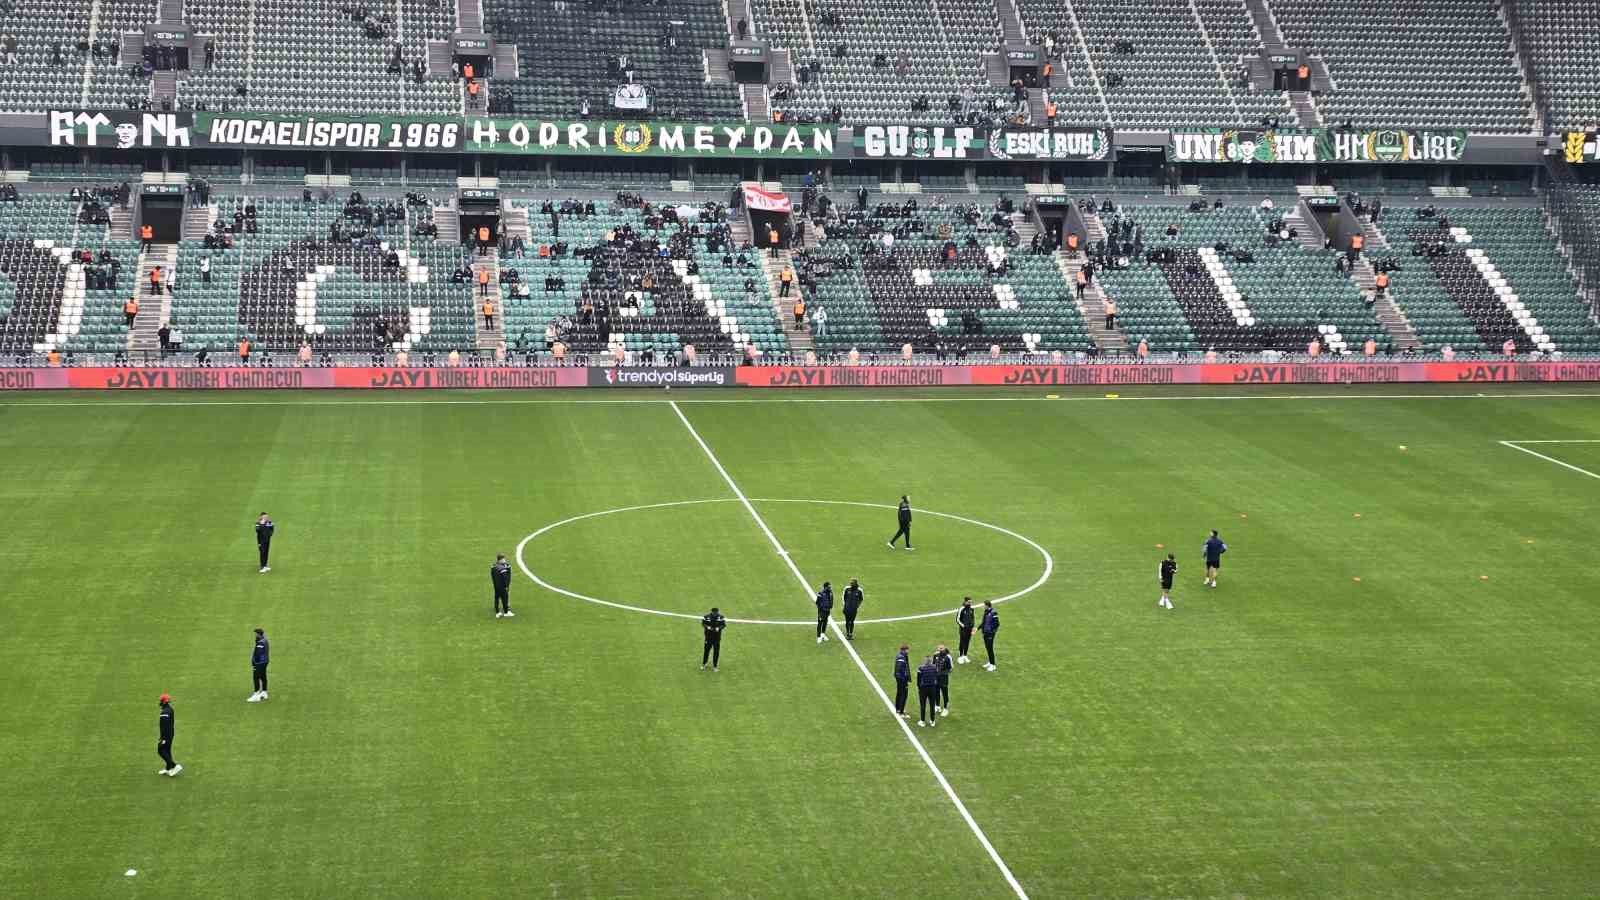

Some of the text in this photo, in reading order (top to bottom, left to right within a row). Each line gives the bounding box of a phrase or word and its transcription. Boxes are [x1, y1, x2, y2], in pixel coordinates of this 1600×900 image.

[210, 118, 458, 148] KOCAELİSPOR 1966
[659, 126, 833, 153] MEYDAN
[1005, 128, 1095, 154] ESKİ RUH
[1274, 135, 1317, 161] HM
[1335, 133, 1369, 160] HM
[225, 371, 302, 387] LAHMACUN
[484, 370, 557, 386] LAHMACUN
[618, 369, 676, 384] trendyol
[875, 369, 943, 385] LAHMACUN
[1107, 367, 1173, 383] LAHMACUN
[1333, 366, 1399, 381] LAHMACUN
